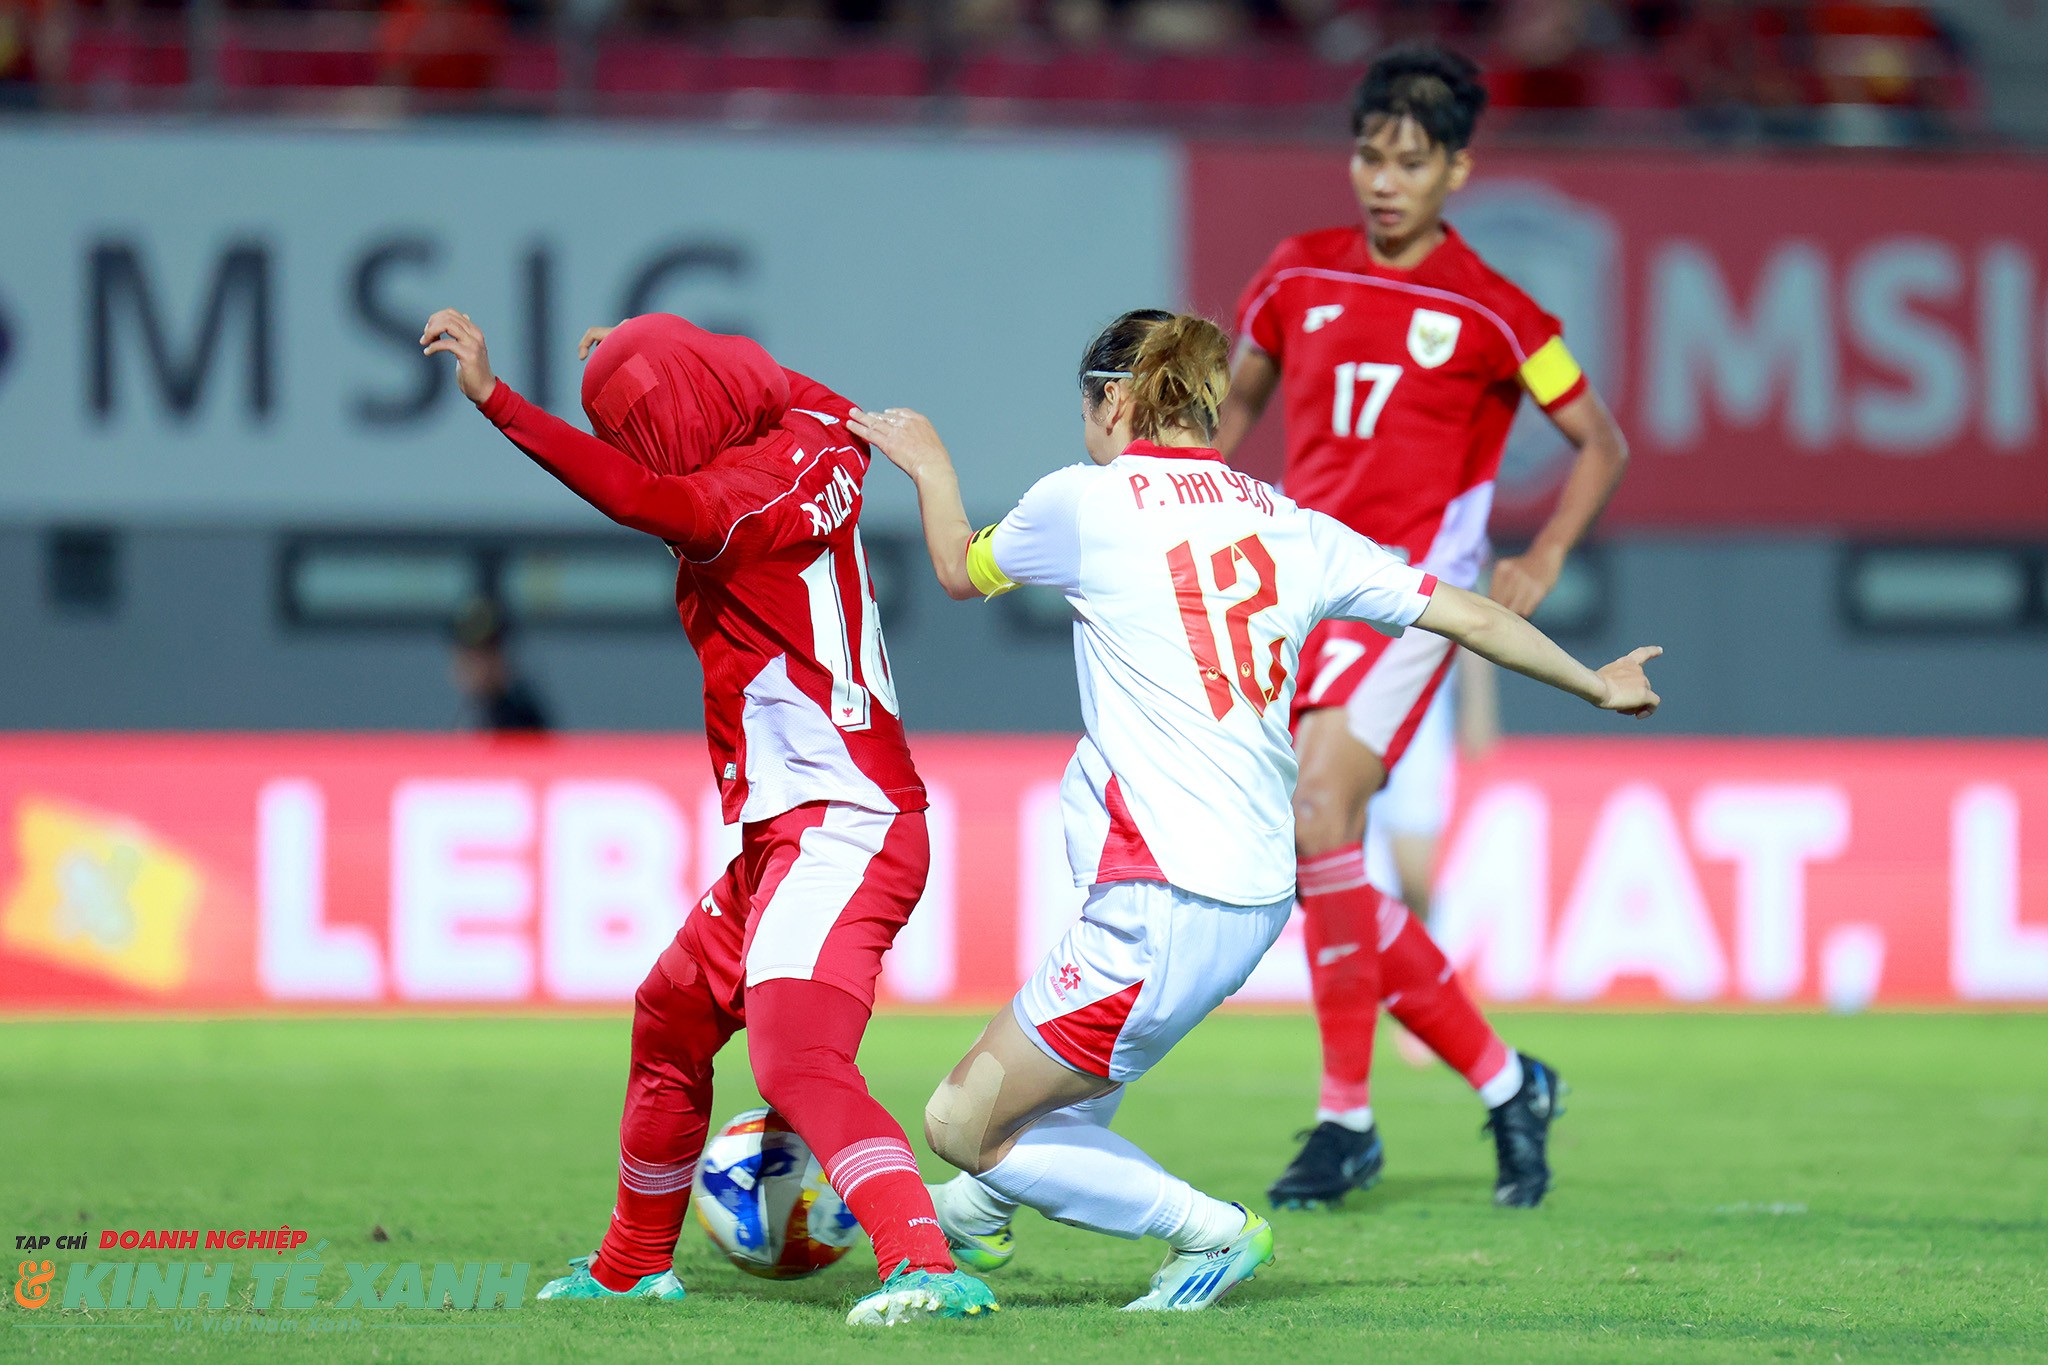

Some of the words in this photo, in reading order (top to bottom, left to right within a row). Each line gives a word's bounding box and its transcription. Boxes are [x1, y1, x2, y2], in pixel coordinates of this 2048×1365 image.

[1332, 361, 1404, 439] 17
[1645, 240, 2048, 450] MSI
[1129, 473, 1165, 510] P.
[1165, 472, 1224, 505] HAI
[798, 523, 901, 738] 16
[1165, 533, 1288, 722] 12
[1308, 637, 1367, 705] 7
[258, 780, 957, 1003] LEB
